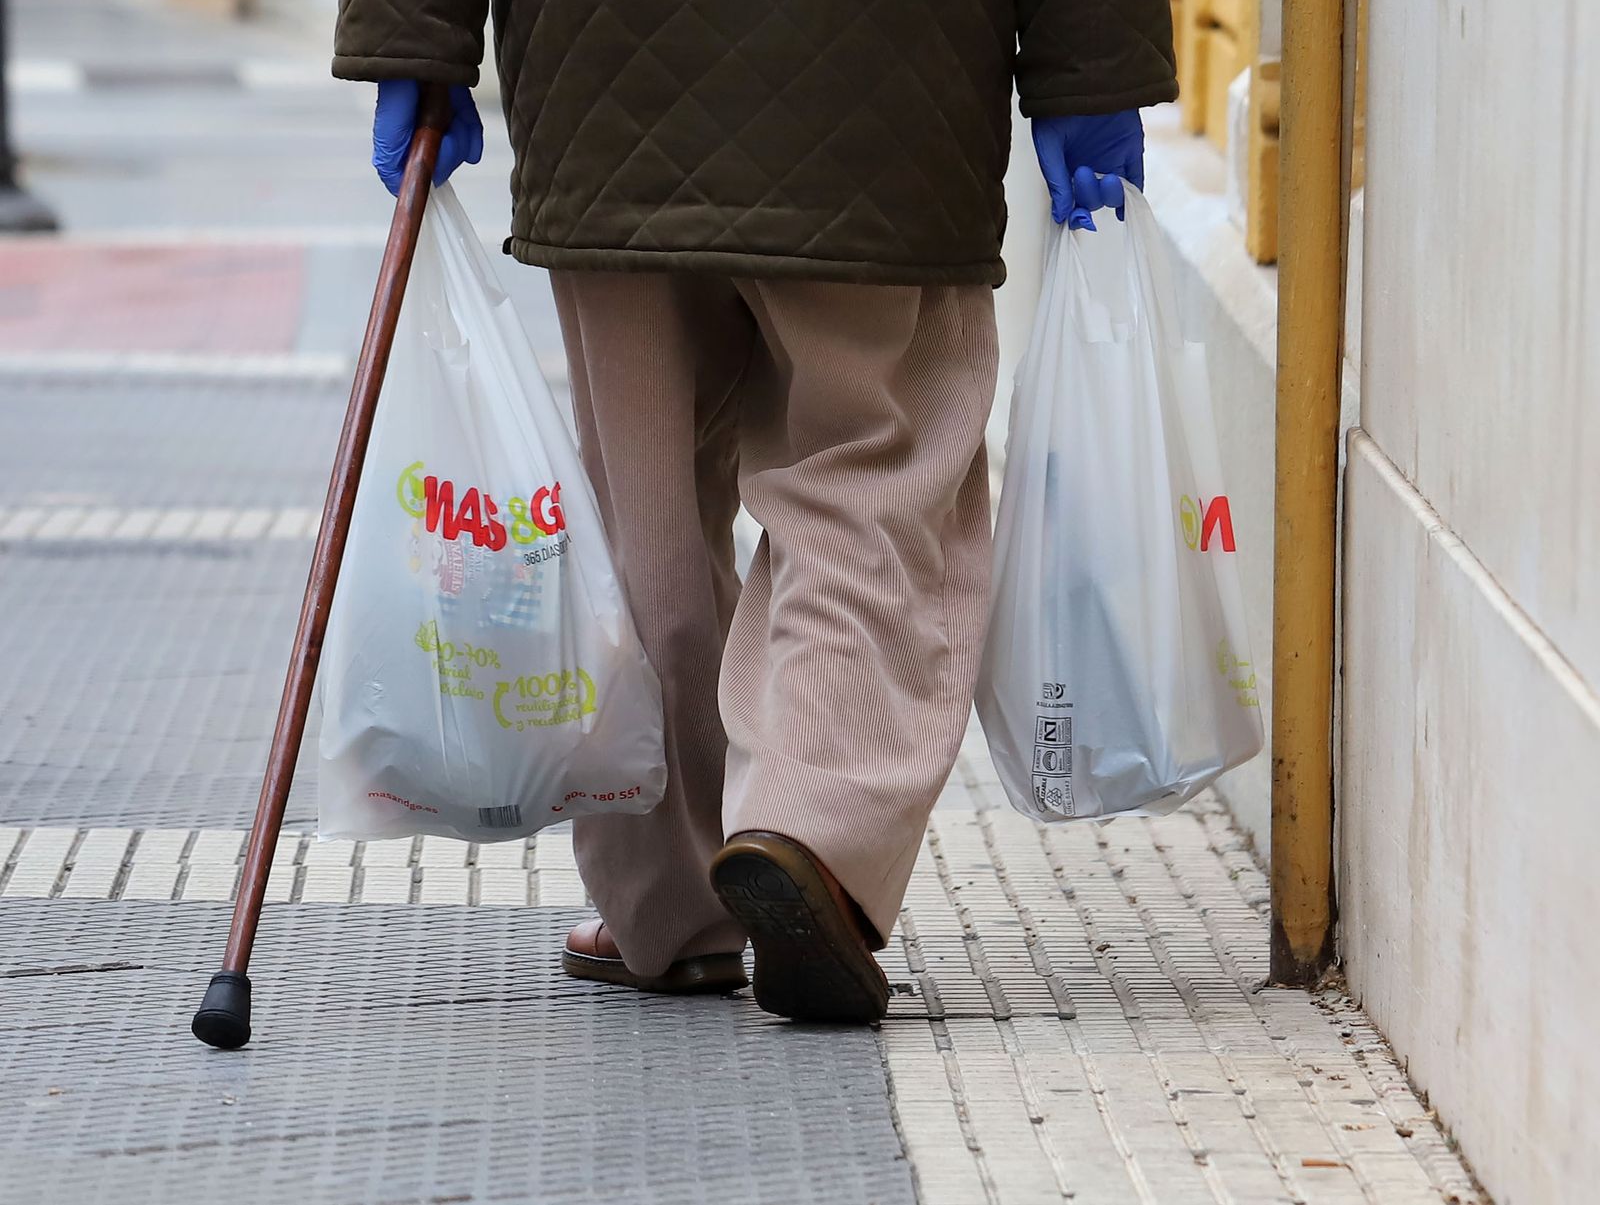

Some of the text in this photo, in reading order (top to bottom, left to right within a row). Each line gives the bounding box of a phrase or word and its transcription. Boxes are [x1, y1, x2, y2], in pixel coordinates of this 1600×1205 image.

[523, 549, 541, 567] 365
[511, 669, 577, 698] 100%
[591, 792, 615, 802] 180
[619, 786, 641, 801] 551
